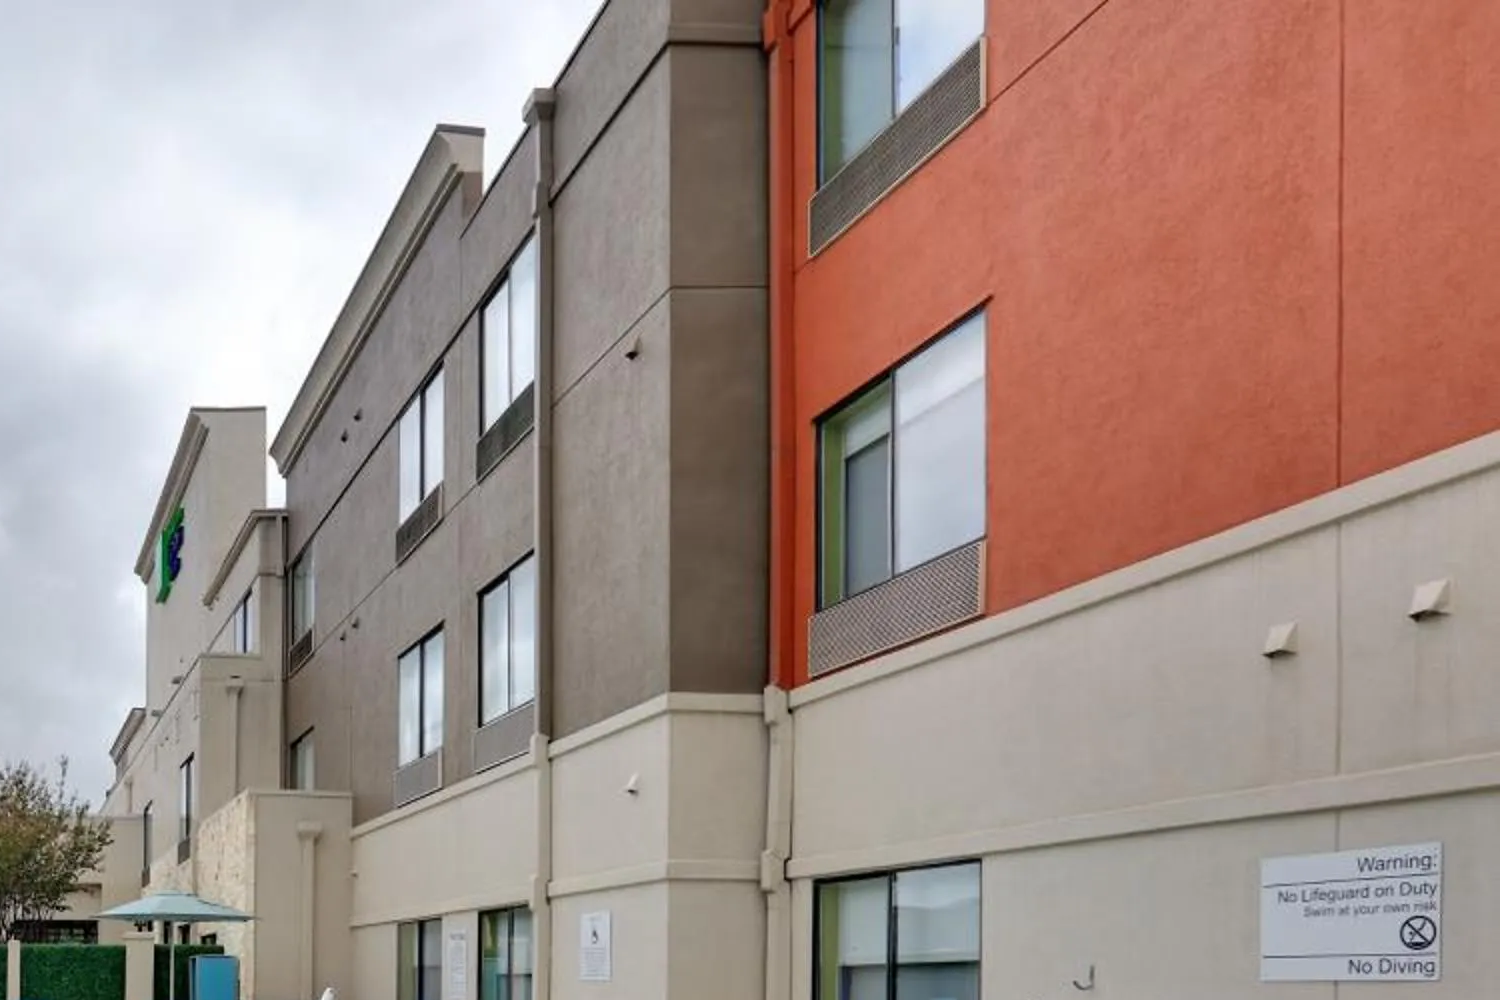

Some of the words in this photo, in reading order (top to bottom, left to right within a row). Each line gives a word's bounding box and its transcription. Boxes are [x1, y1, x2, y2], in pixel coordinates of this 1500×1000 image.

[1357, 854, 1437, 872] Warning:
[1277, 890, 1297, 903] No
[1301, 886, 1369, 902] Lifeguard
[1374, 884, 1394, 897] on
[1400, 881, 1437, 897] Duty
[1303, 906, 1334, 917] Swim
[1338, 905, 1349, 915] at
[1353, 904, 1379, 916] your
[1383, 903, 1410, 913] own
[1414, 901, 1437, 912] risk
[1348, 959, 1373, 974] No
[1379, 958, 1435, 977] Diving
